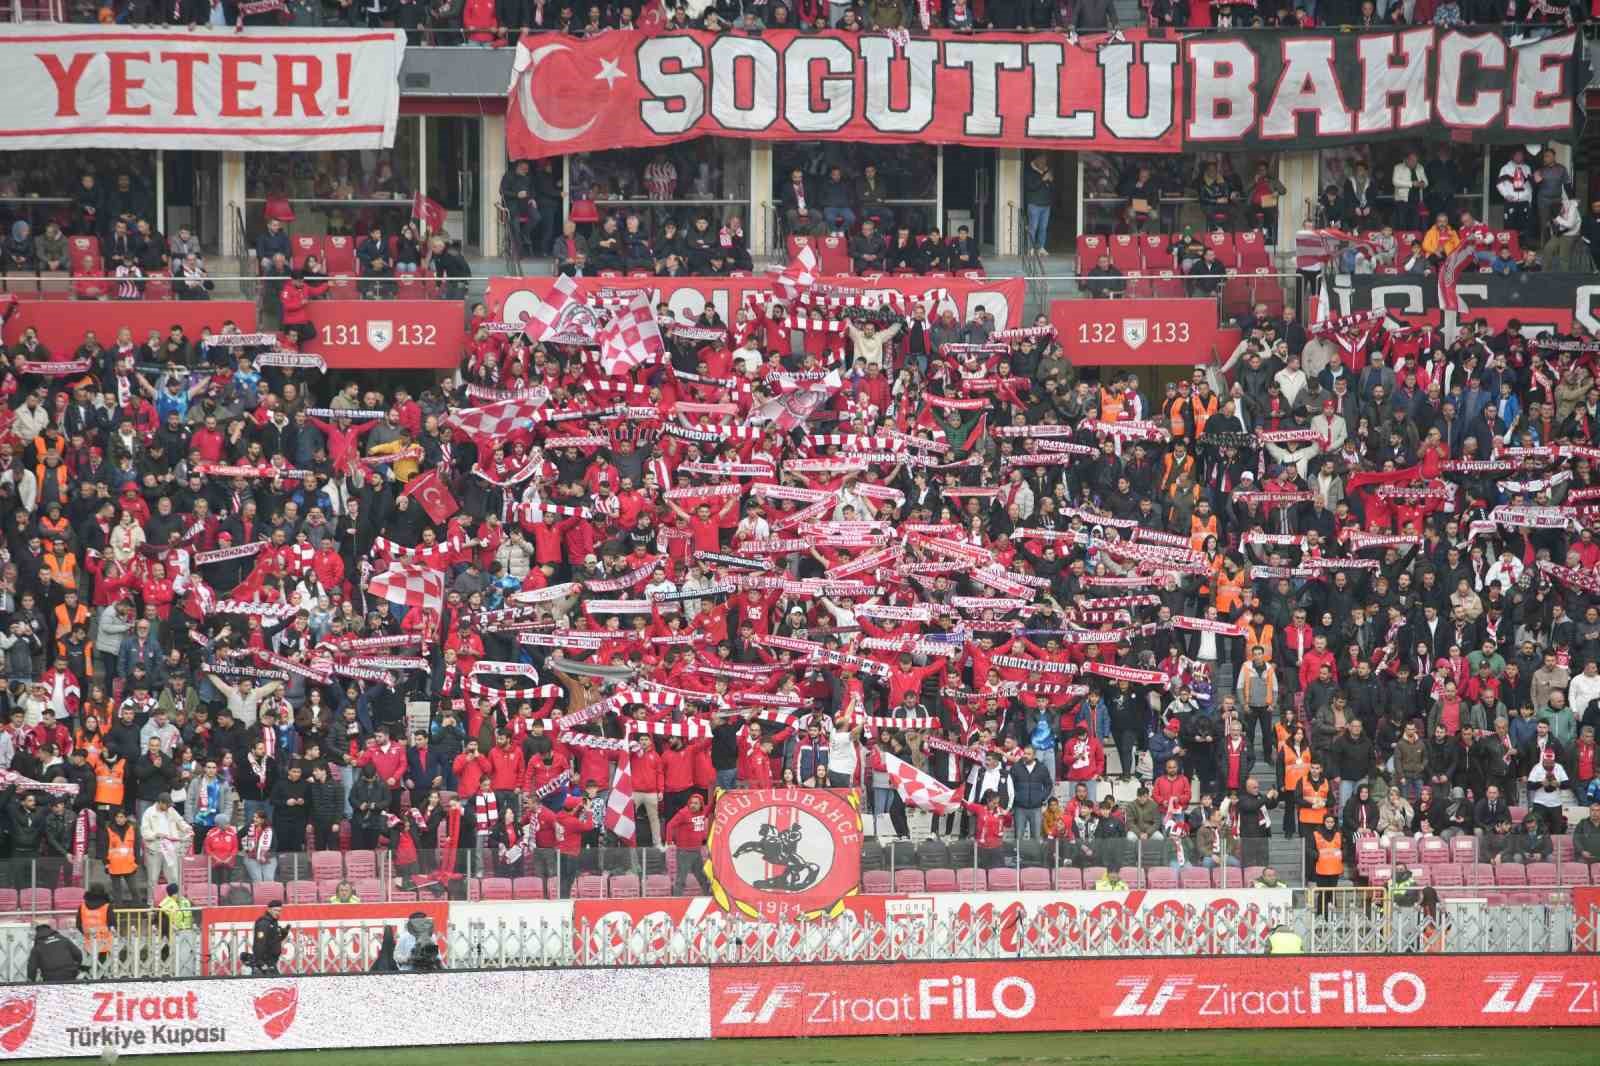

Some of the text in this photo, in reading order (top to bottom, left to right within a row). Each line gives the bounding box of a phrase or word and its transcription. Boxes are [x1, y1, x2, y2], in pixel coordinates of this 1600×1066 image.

[35, 53, 353, 118] YETER!
[322, 325, 436, 345] 131 132
[1079, 323, 1190, 343] 132 133
[91, 991, 199, 1022] Ziraat
[721, 975, 1036, 1024] ZF Ziraat FiLO
[1112, 970, 1426, 1017] ZF Ziraat FiLO
[1481, 971, 1564, 1013] ZF
[66, 1025, 226, 1048] Türkiye Kupası
